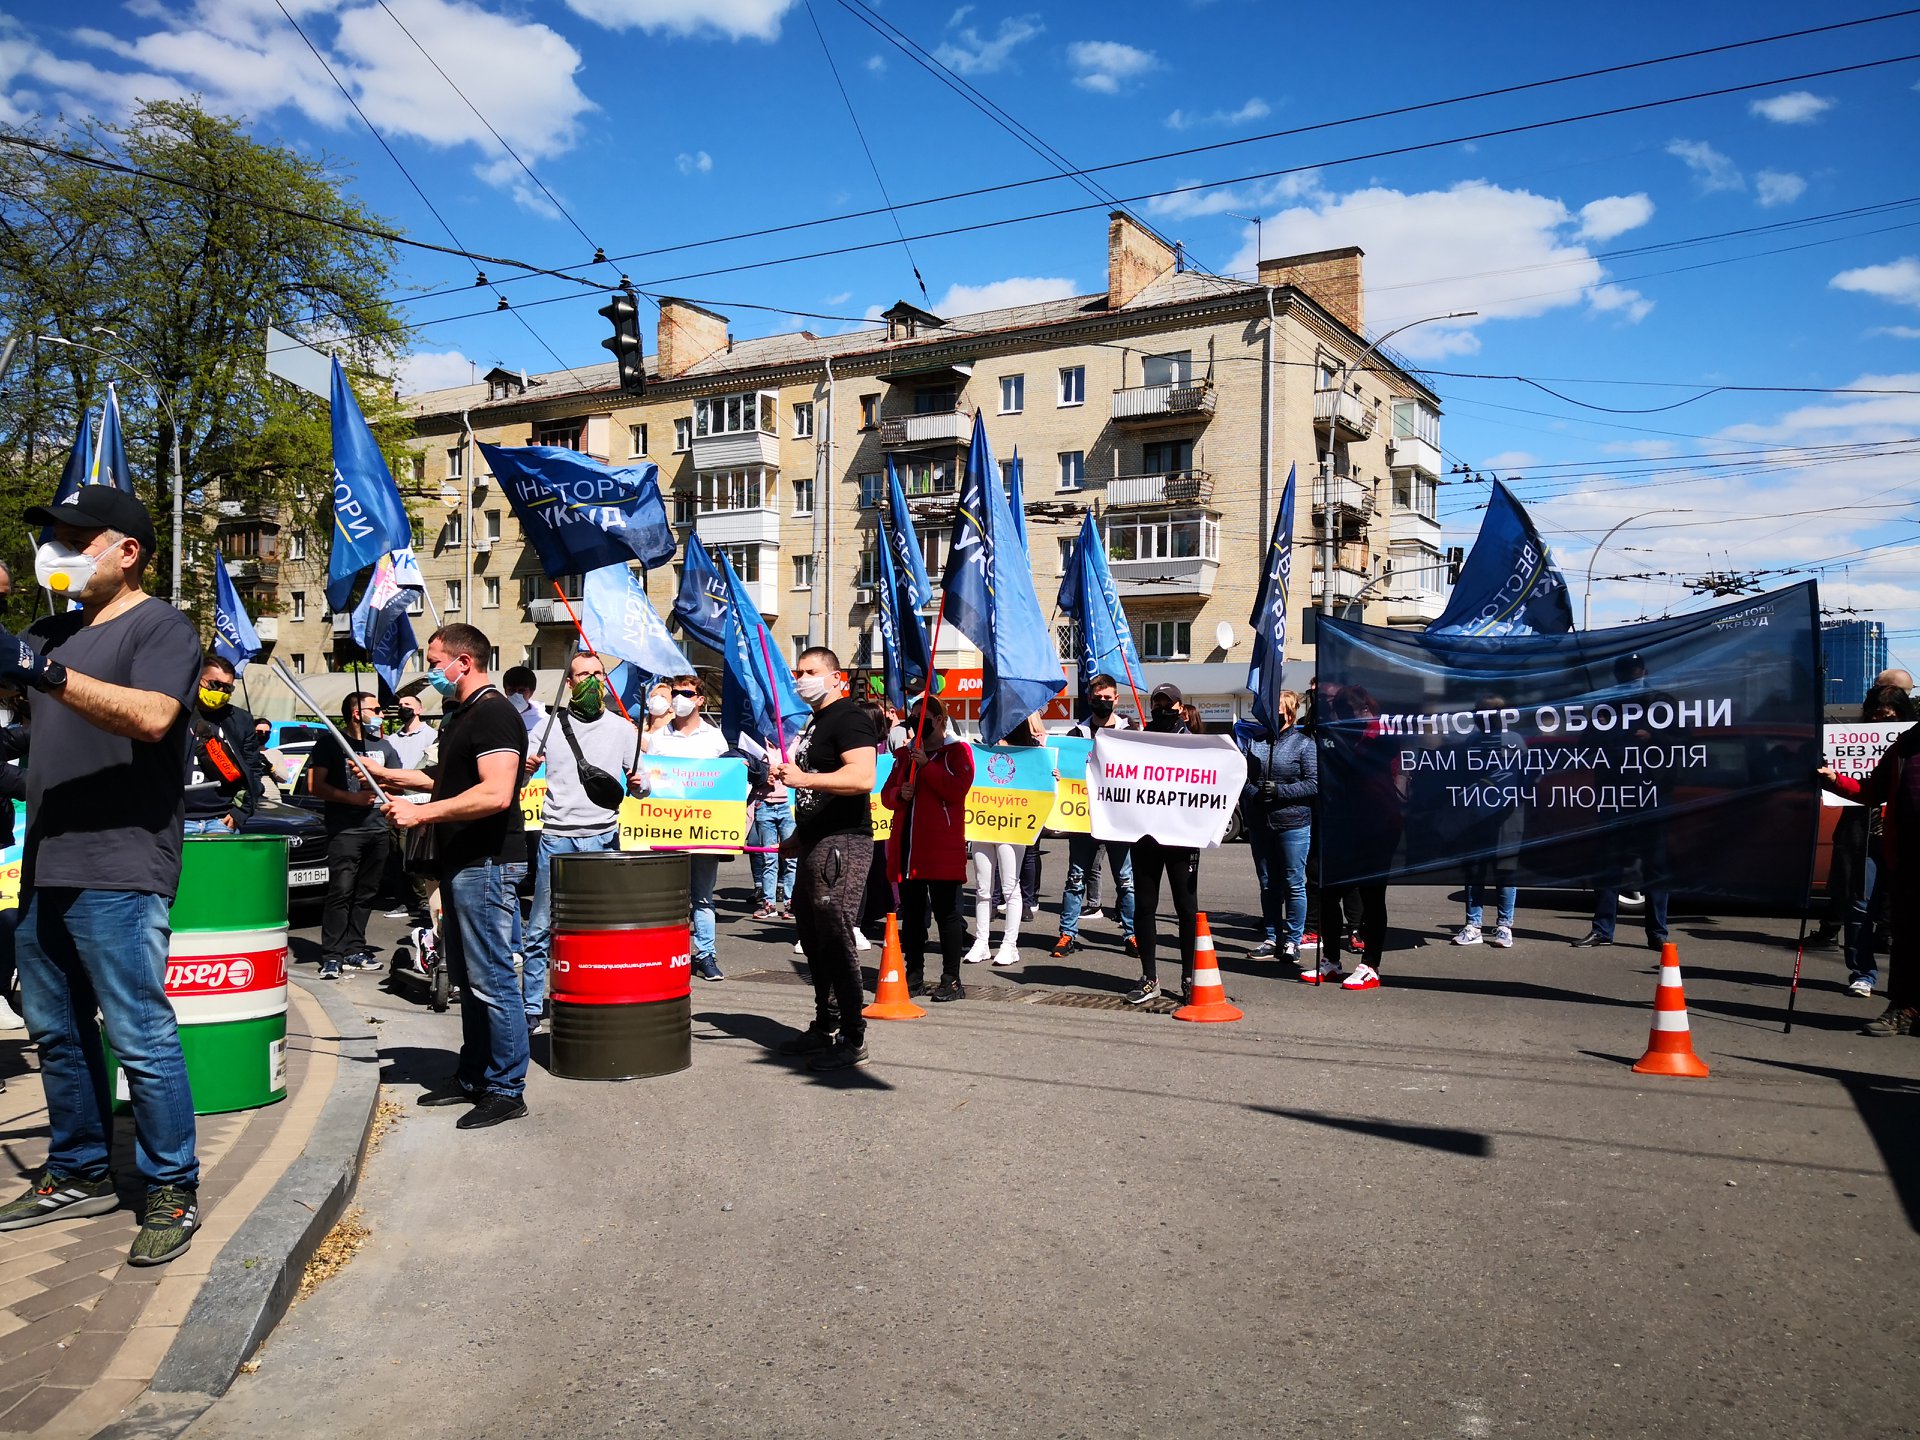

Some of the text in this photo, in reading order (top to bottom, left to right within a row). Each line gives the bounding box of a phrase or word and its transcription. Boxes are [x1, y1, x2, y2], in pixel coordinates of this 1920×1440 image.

[1716, 616, 1769, 632] УКРБУД
[1378, 698, 1733, 736] МІНІСТР ОБОРОНИ
[1828, 732, 1880, 744] 13000
[206, 739, 236, 778] Superdry
[1400, 744, 1708, 775] ВАМ БАЙДУЖА ДОЛЯ
[1835, 745, 1866, 757] БЕЗ
[1852, 758, 1882, 770] БЛ
[1105, 763, 1218, 785] НАМ ПОТРІБНІ
[971, 791, 1028, 808] Почуйте
[1097, 786, 1227, 810] НАШІ КВАРТИРИ!
[1446, 780, 1658, 813] ТИСЯЧ ЛЮДЕЙ
[640, 803, 712, 822] Почуйте
[964, 809, 1037, 831] Оберіг 2
[618, 823, 740, 842] арівне Місто
[293, 871, 313, 882] 1811
